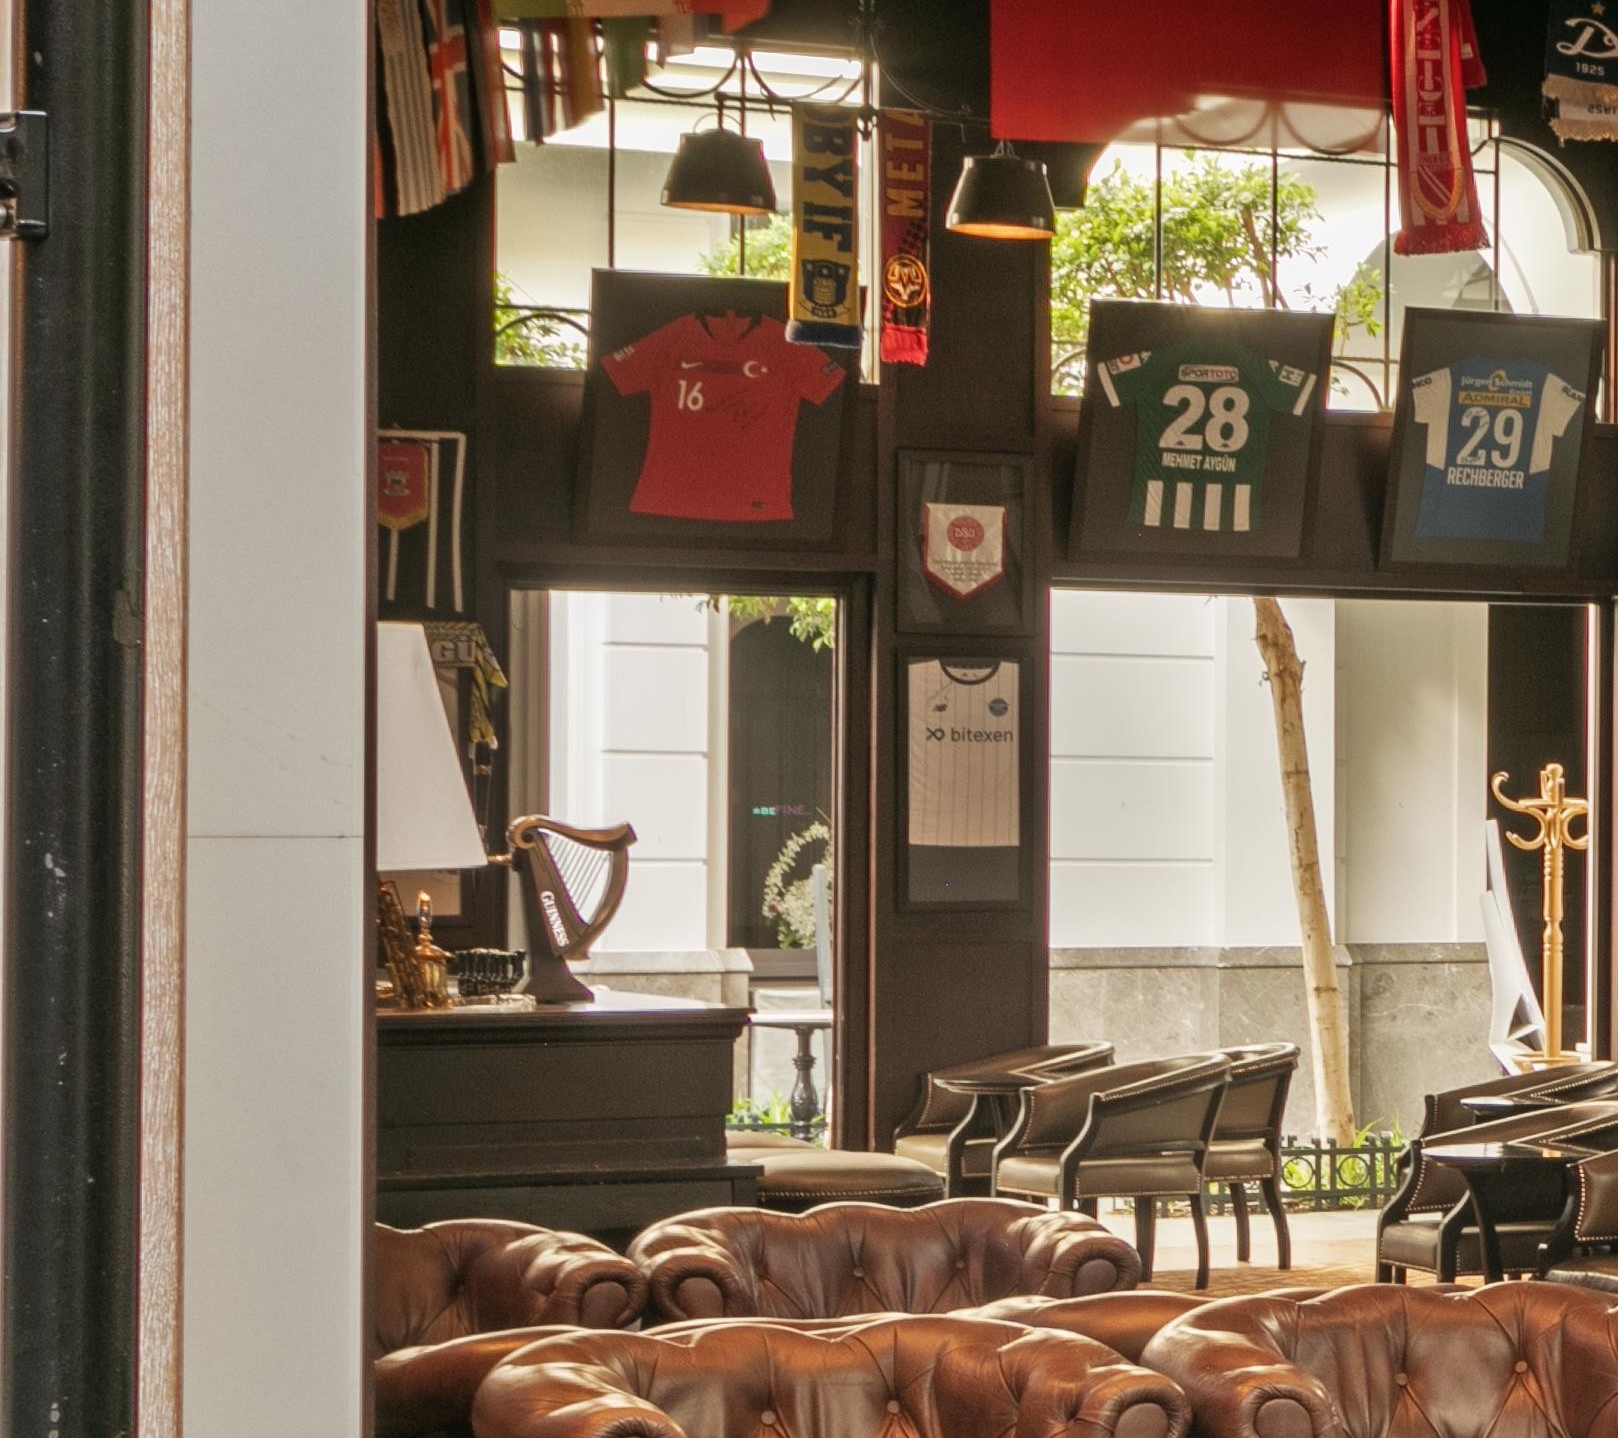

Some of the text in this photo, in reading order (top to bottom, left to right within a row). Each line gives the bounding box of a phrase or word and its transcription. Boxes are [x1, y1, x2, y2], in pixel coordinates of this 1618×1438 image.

[1575, 61, 1606, 77] 1925
[677, 379, 705, 411] 16
[1158, 383, 1251, 453] 28
[1455, 406, 1524, 469] 29
[1161, 451, 1237, 473] MEHMET AYGÜN
[1446, 466, 1525, 489] RECHBERGER
[951, 727, 1014, 742] bitexen
[541, 890, 570, 947] GUINNESS
